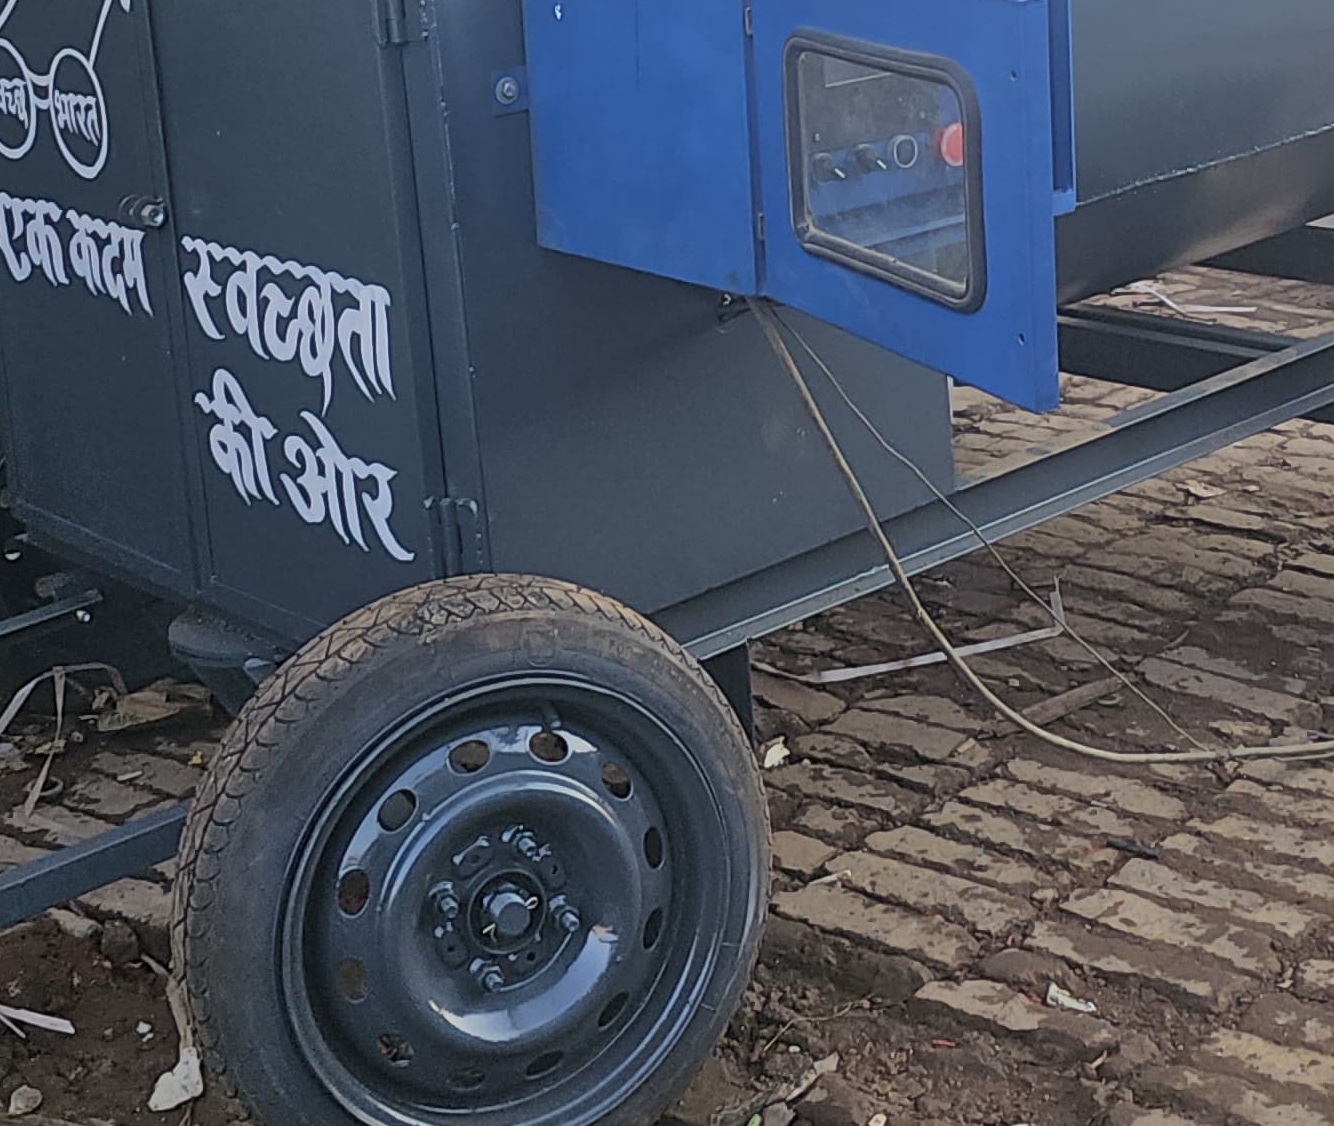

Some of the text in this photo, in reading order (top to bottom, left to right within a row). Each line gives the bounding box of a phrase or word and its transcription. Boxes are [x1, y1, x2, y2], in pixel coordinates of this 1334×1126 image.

[54, 89, 101, 147] भारत
[66, 209, 155, 318] कदम
[195, 368, 416, 563] की ओर
